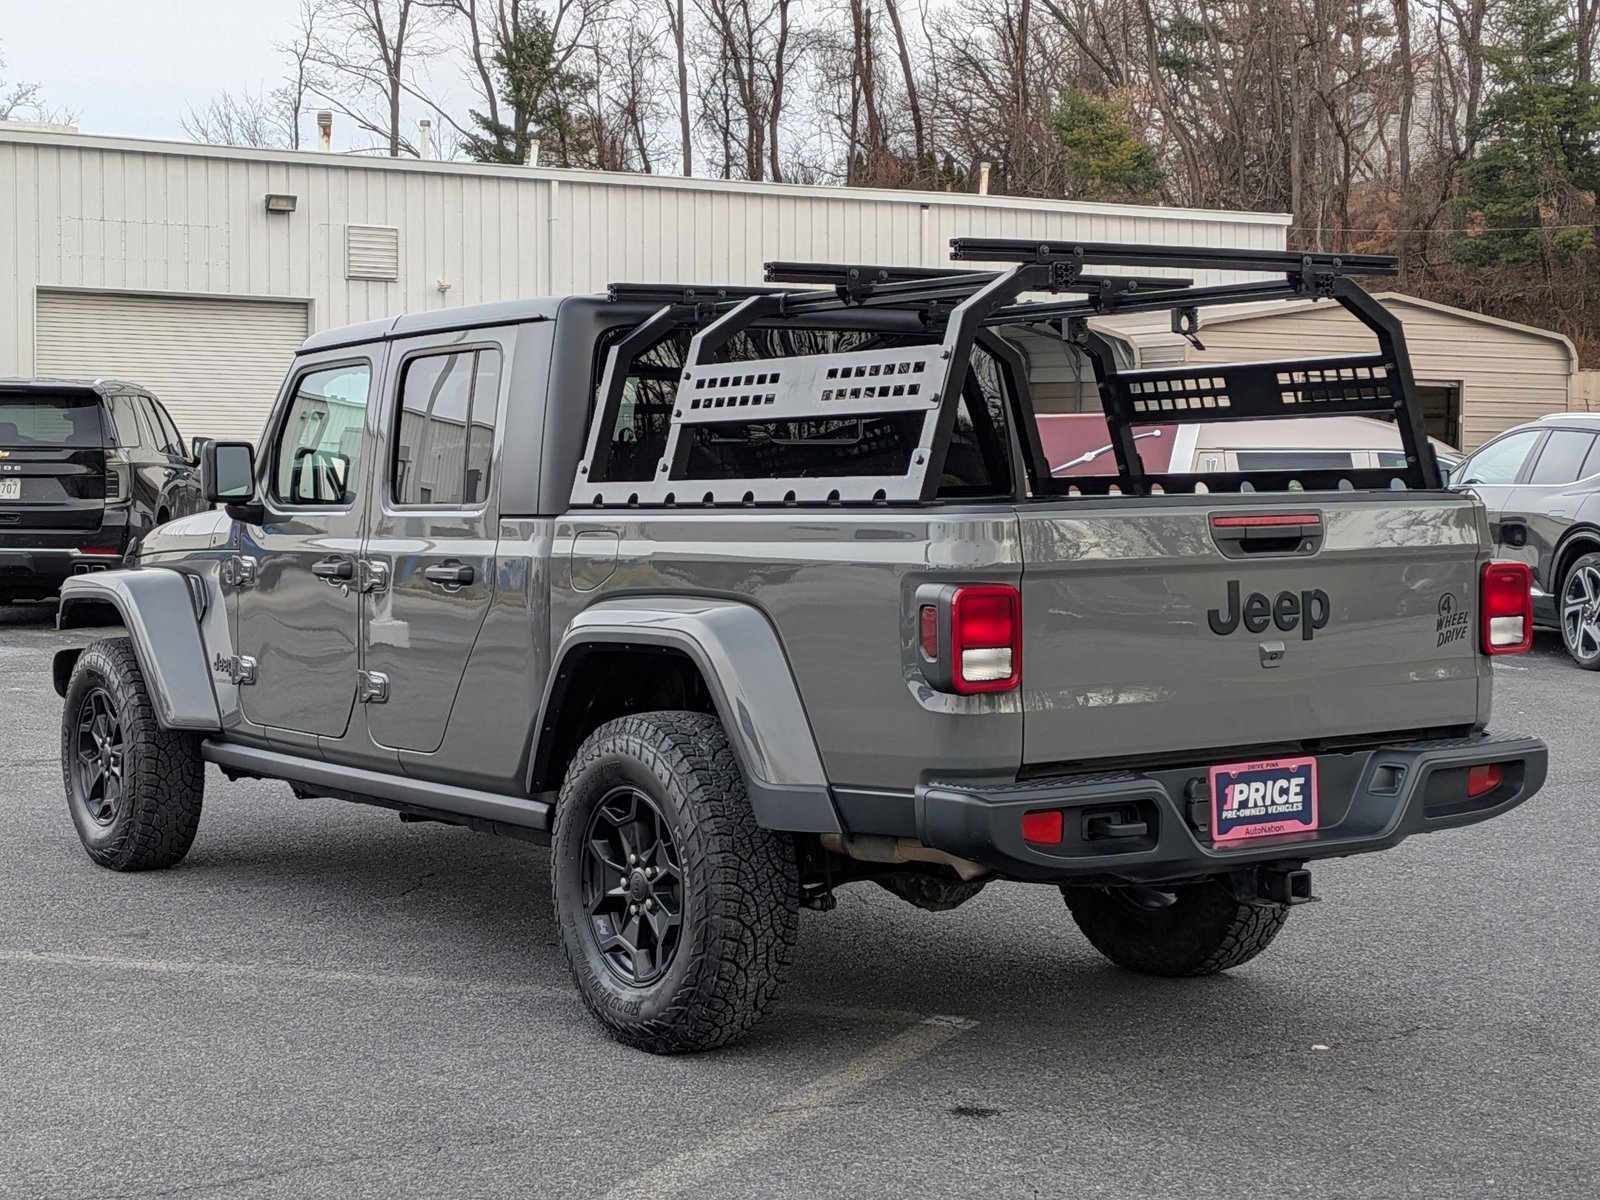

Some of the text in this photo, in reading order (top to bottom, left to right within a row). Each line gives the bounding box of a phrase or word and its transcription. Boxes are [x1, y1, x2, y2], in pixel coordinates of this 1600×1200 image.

[1207, 580, 1331, 641] Jeep
[1436, 611, 1468, 632] WHEEL
[1436, 626, 1468, 648] DRIVE
[1222, 803, 1303, 820] PRE-OWNED VEHICLES
[1245, 824, 1285, 836] AutoNation
